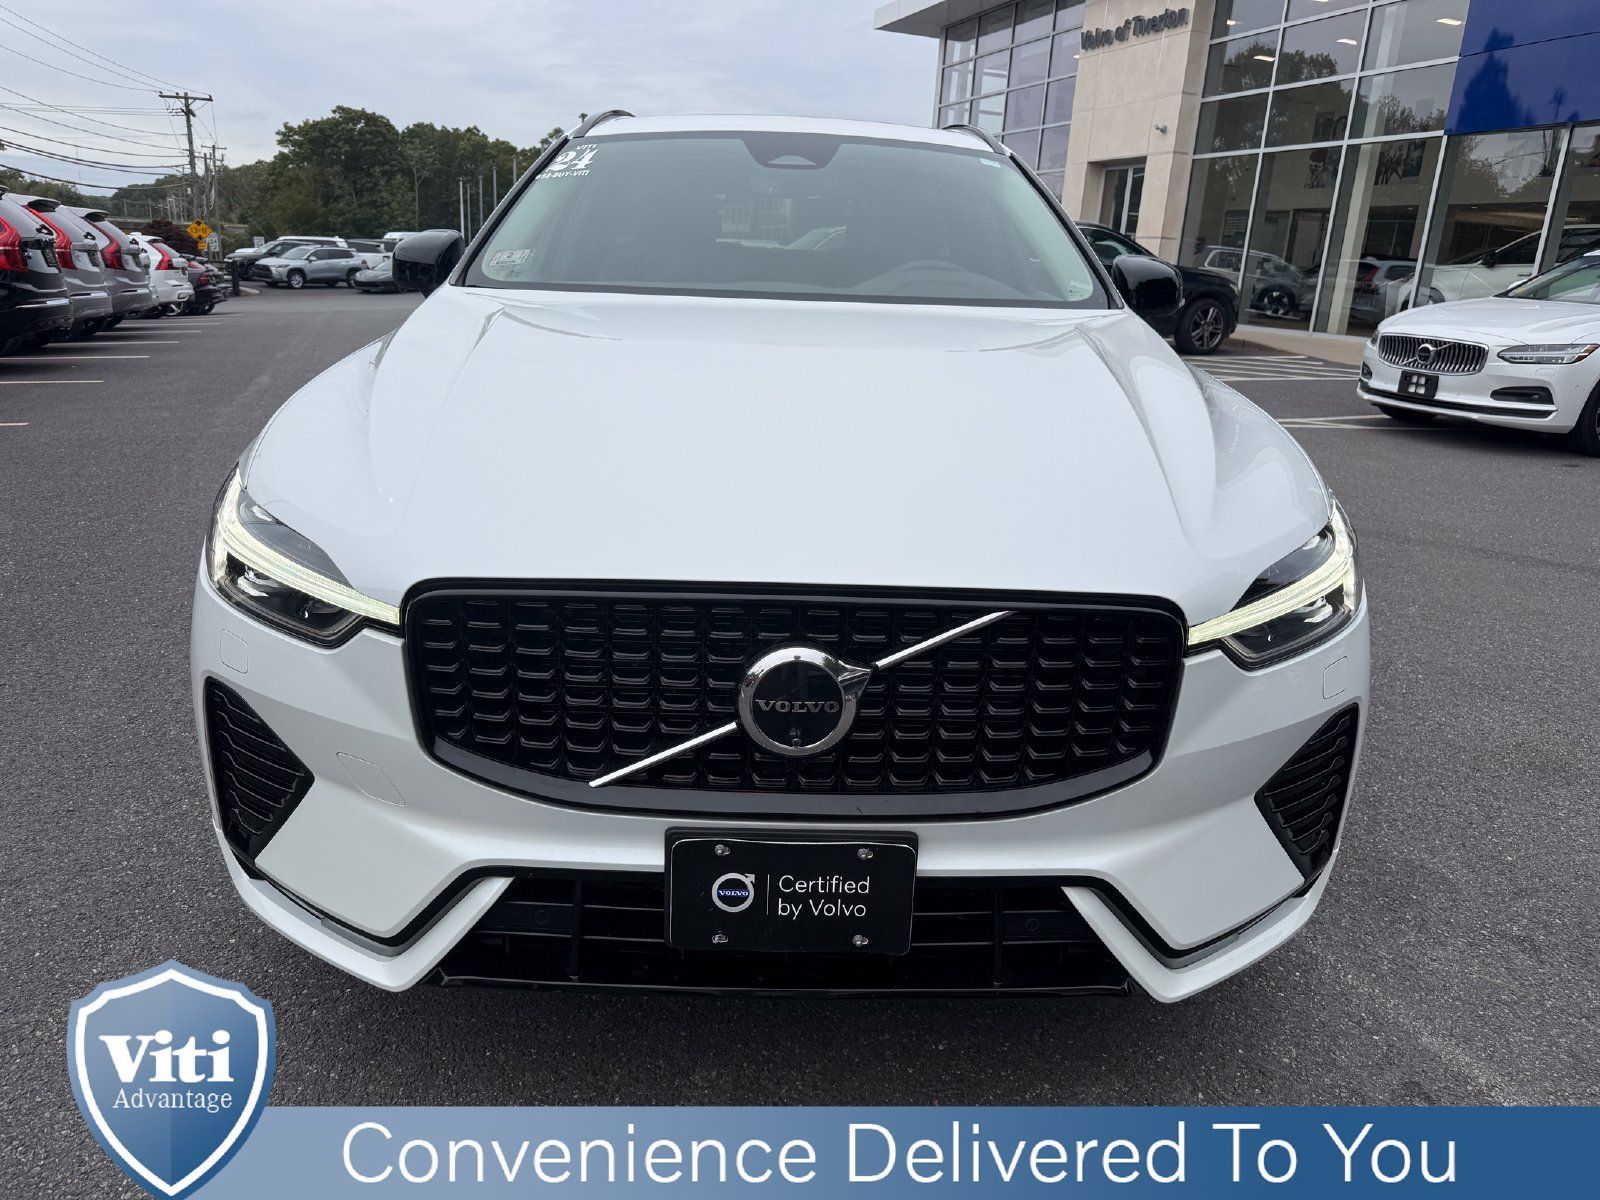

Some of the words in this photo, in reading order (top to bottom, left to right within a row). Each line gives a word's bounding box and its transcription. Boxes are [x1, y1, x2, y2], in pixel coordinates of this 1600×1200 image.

[1080, 27, 1115, 50] Volvo
[1115, 18, 1132, 42] of
[1132, 7, 1189, 37] Tiverton
[546, 149, 599, 172] 24
[755, 698, 840, 714] VOLVO
[778, 874, 870, 894] Certified
[778, 898, 803, 921] by
[809, 898, 867, 917] Volvo
